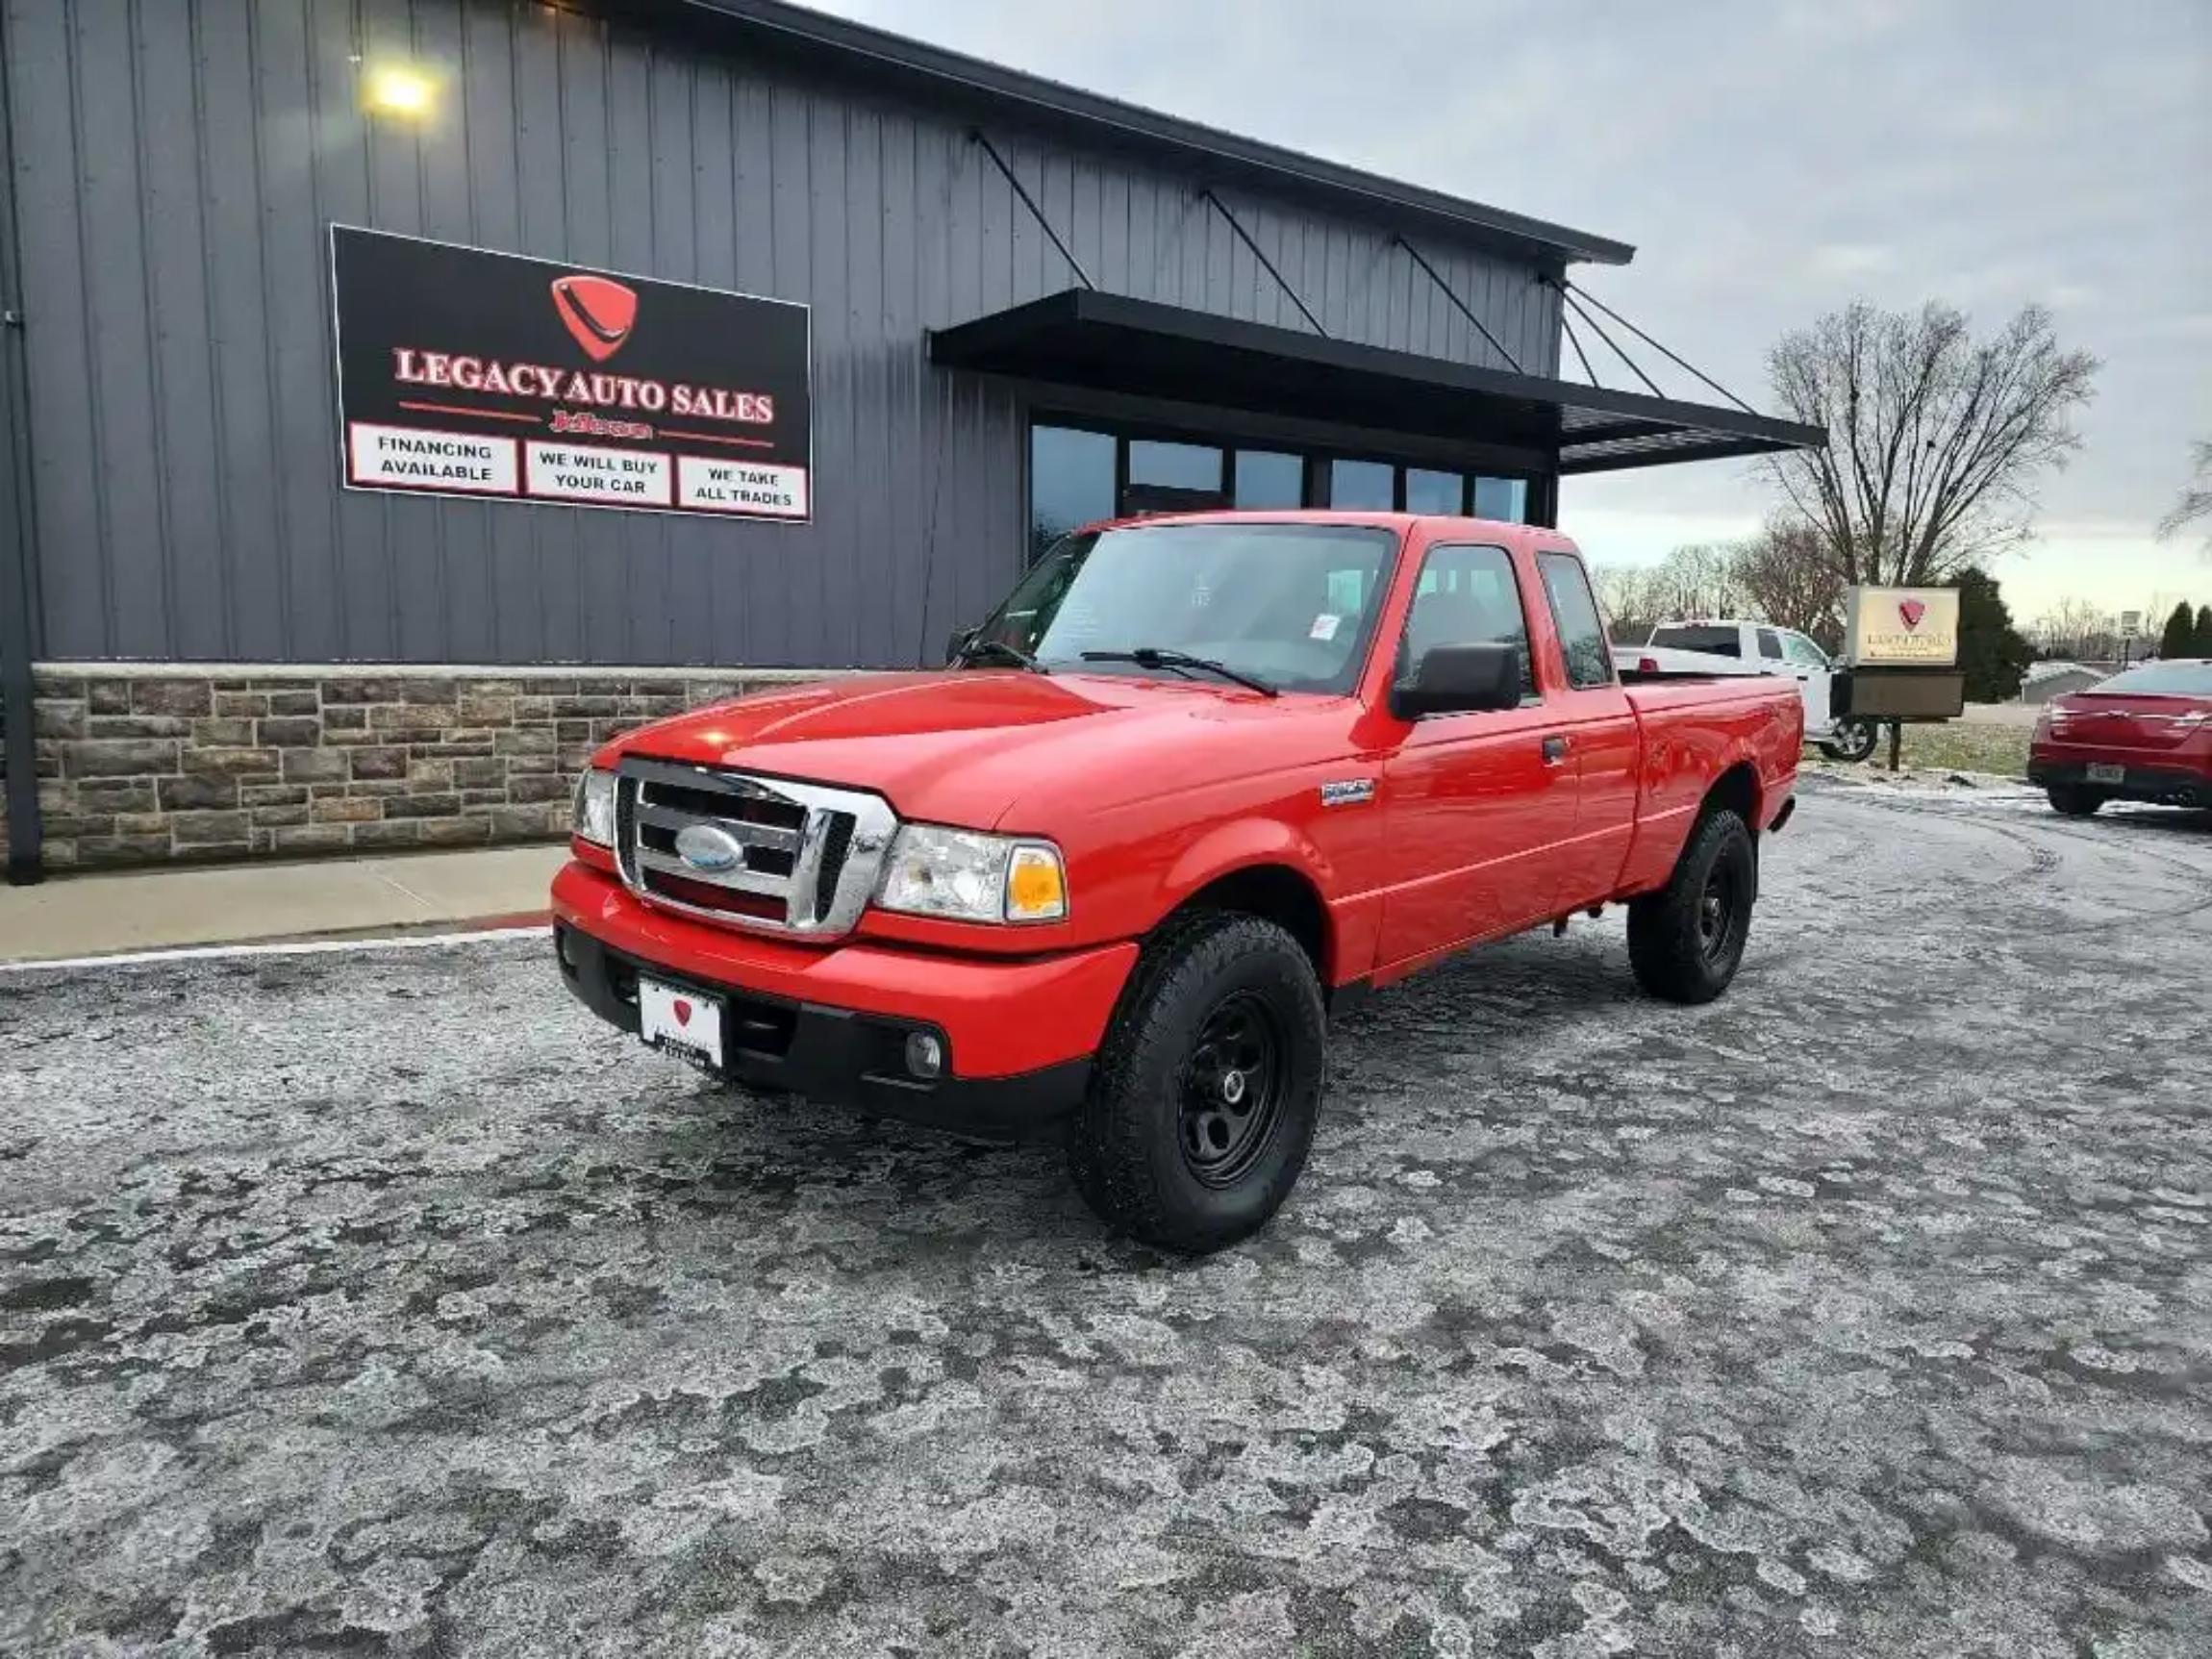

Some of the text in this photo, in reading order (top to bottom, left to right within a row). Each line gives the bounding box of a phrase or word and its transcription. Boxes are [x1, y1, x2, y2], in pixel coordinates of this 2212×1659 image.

[392, 347, 773, 424] LEGACY AUTO SALES
[378, 436, 492, 460] FINANCING
[381, 460, 493, 481] AVAILABLE
[539, 451, 657, 474] WE WILL BUY
[555, 474, 645, 493] YOUR CAR
[708, 467, 778, 487] WE TAKE
[696, 487, 792, 507] ALL TRADES
